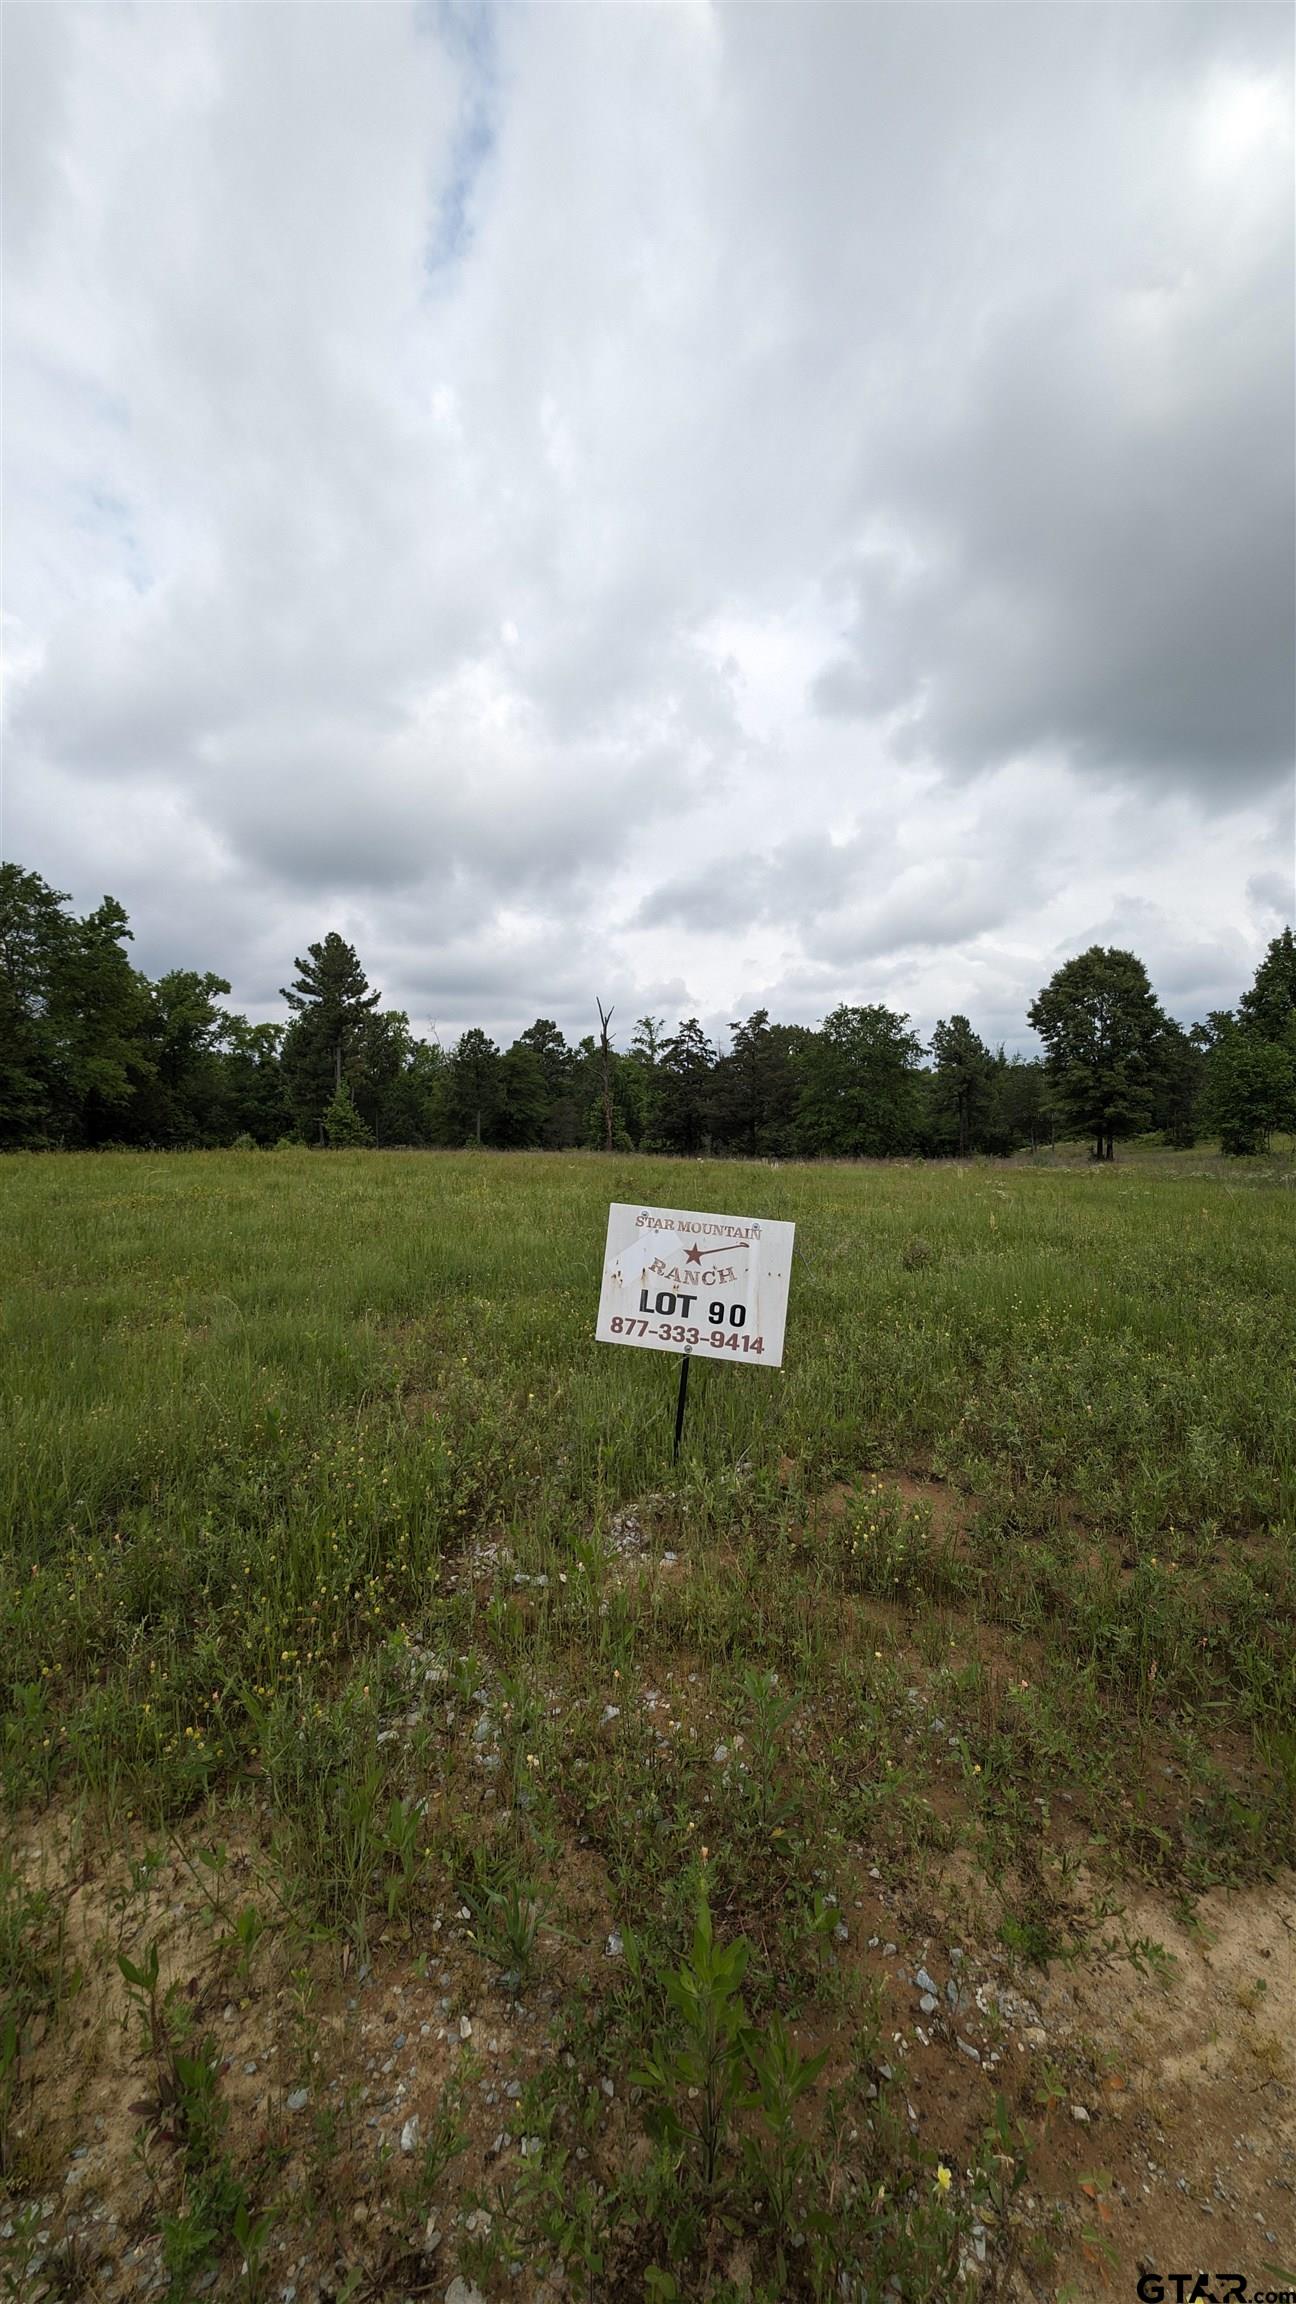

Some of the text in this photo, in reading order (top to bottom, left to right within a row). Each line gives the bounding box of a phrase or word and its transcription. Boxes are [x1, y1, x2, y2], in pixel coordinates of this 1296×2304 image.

[635, 1216, 763, 1240] STAR MOUNTAIN
[648, 1257, 738, 1286] RANCH
[639, 1289, 746, 1328] LOT 90
[610, 1316, 765, 1354] 877-333-9414
